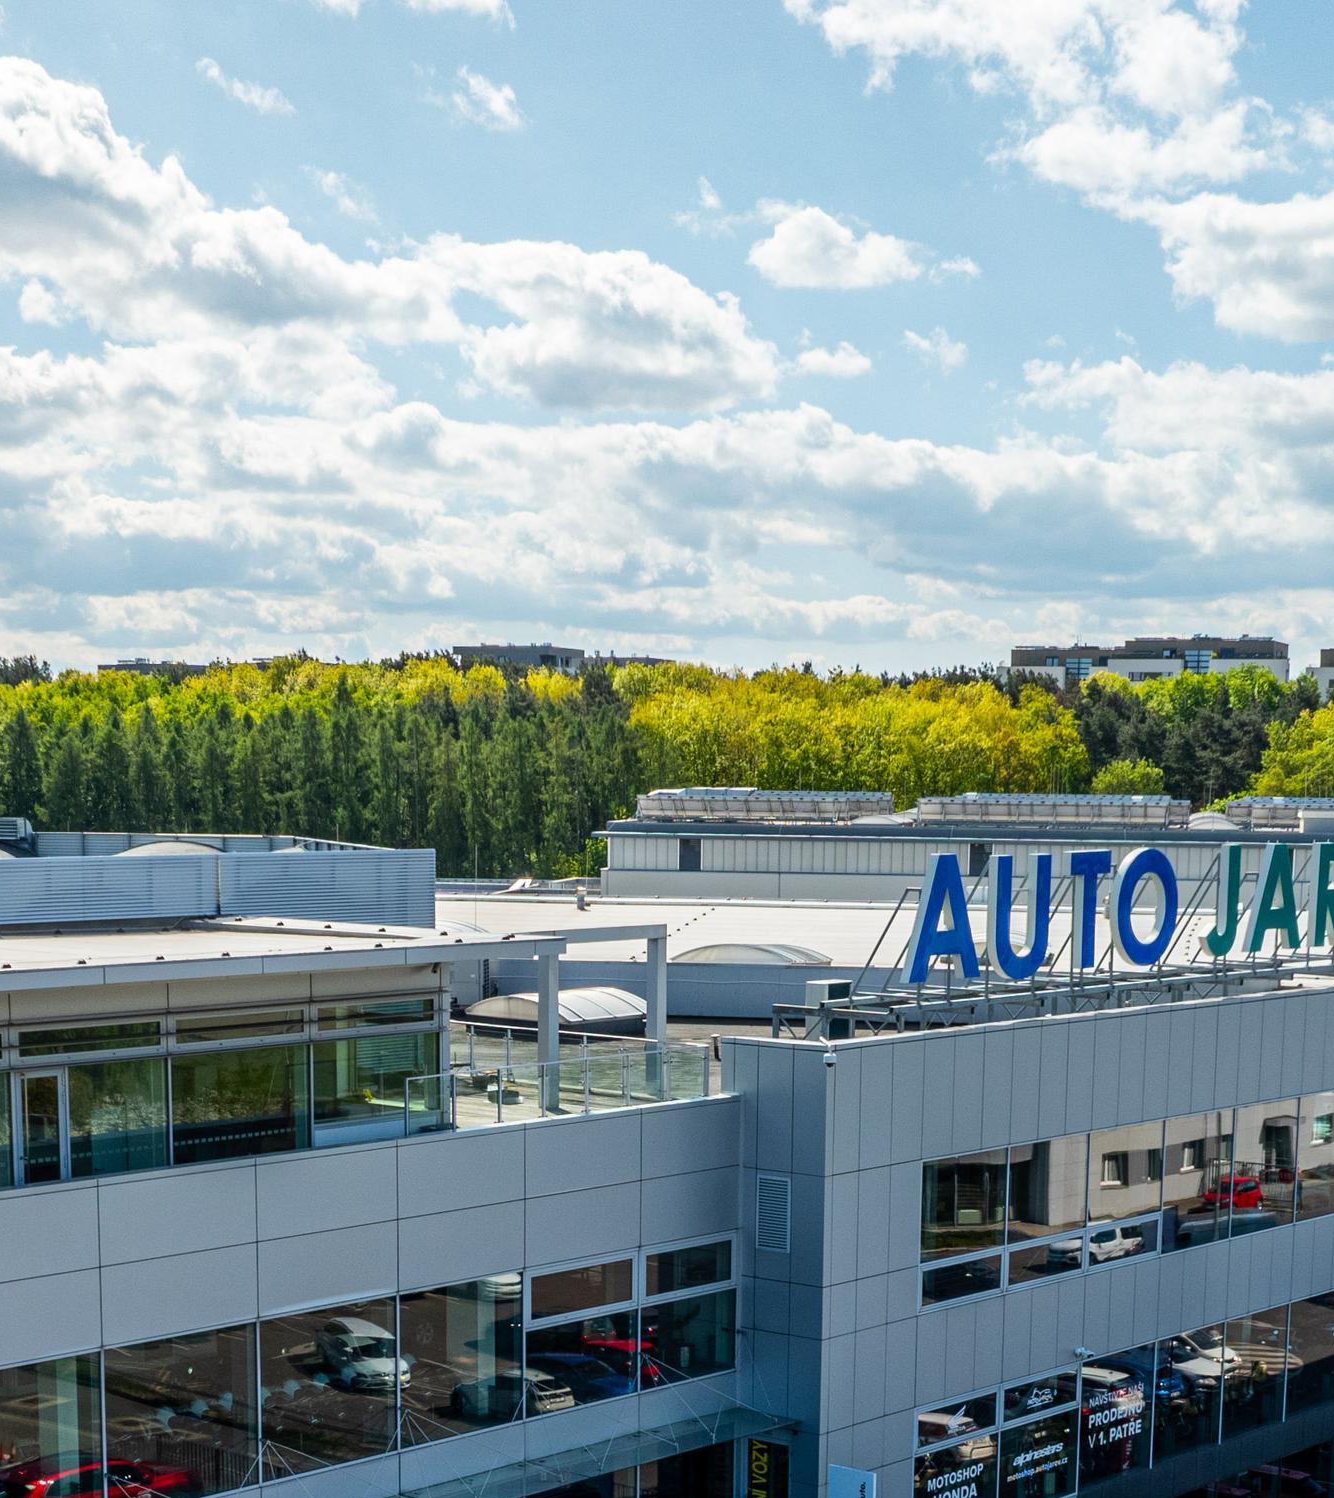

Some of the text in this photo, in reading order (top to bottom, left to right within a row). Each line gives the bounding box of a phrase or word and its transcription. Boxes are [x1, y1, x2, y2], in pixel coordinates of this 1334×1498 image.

[900, 846, 1179, 984] AUTO
[1098, 1431, 1107, 1446] 1.
[1109, 1418, 1142, 1443] PATŘE
[751, 1440, 769, 1483] VOZY
[927, 1463, 984, 1493] MOTOSHOP
